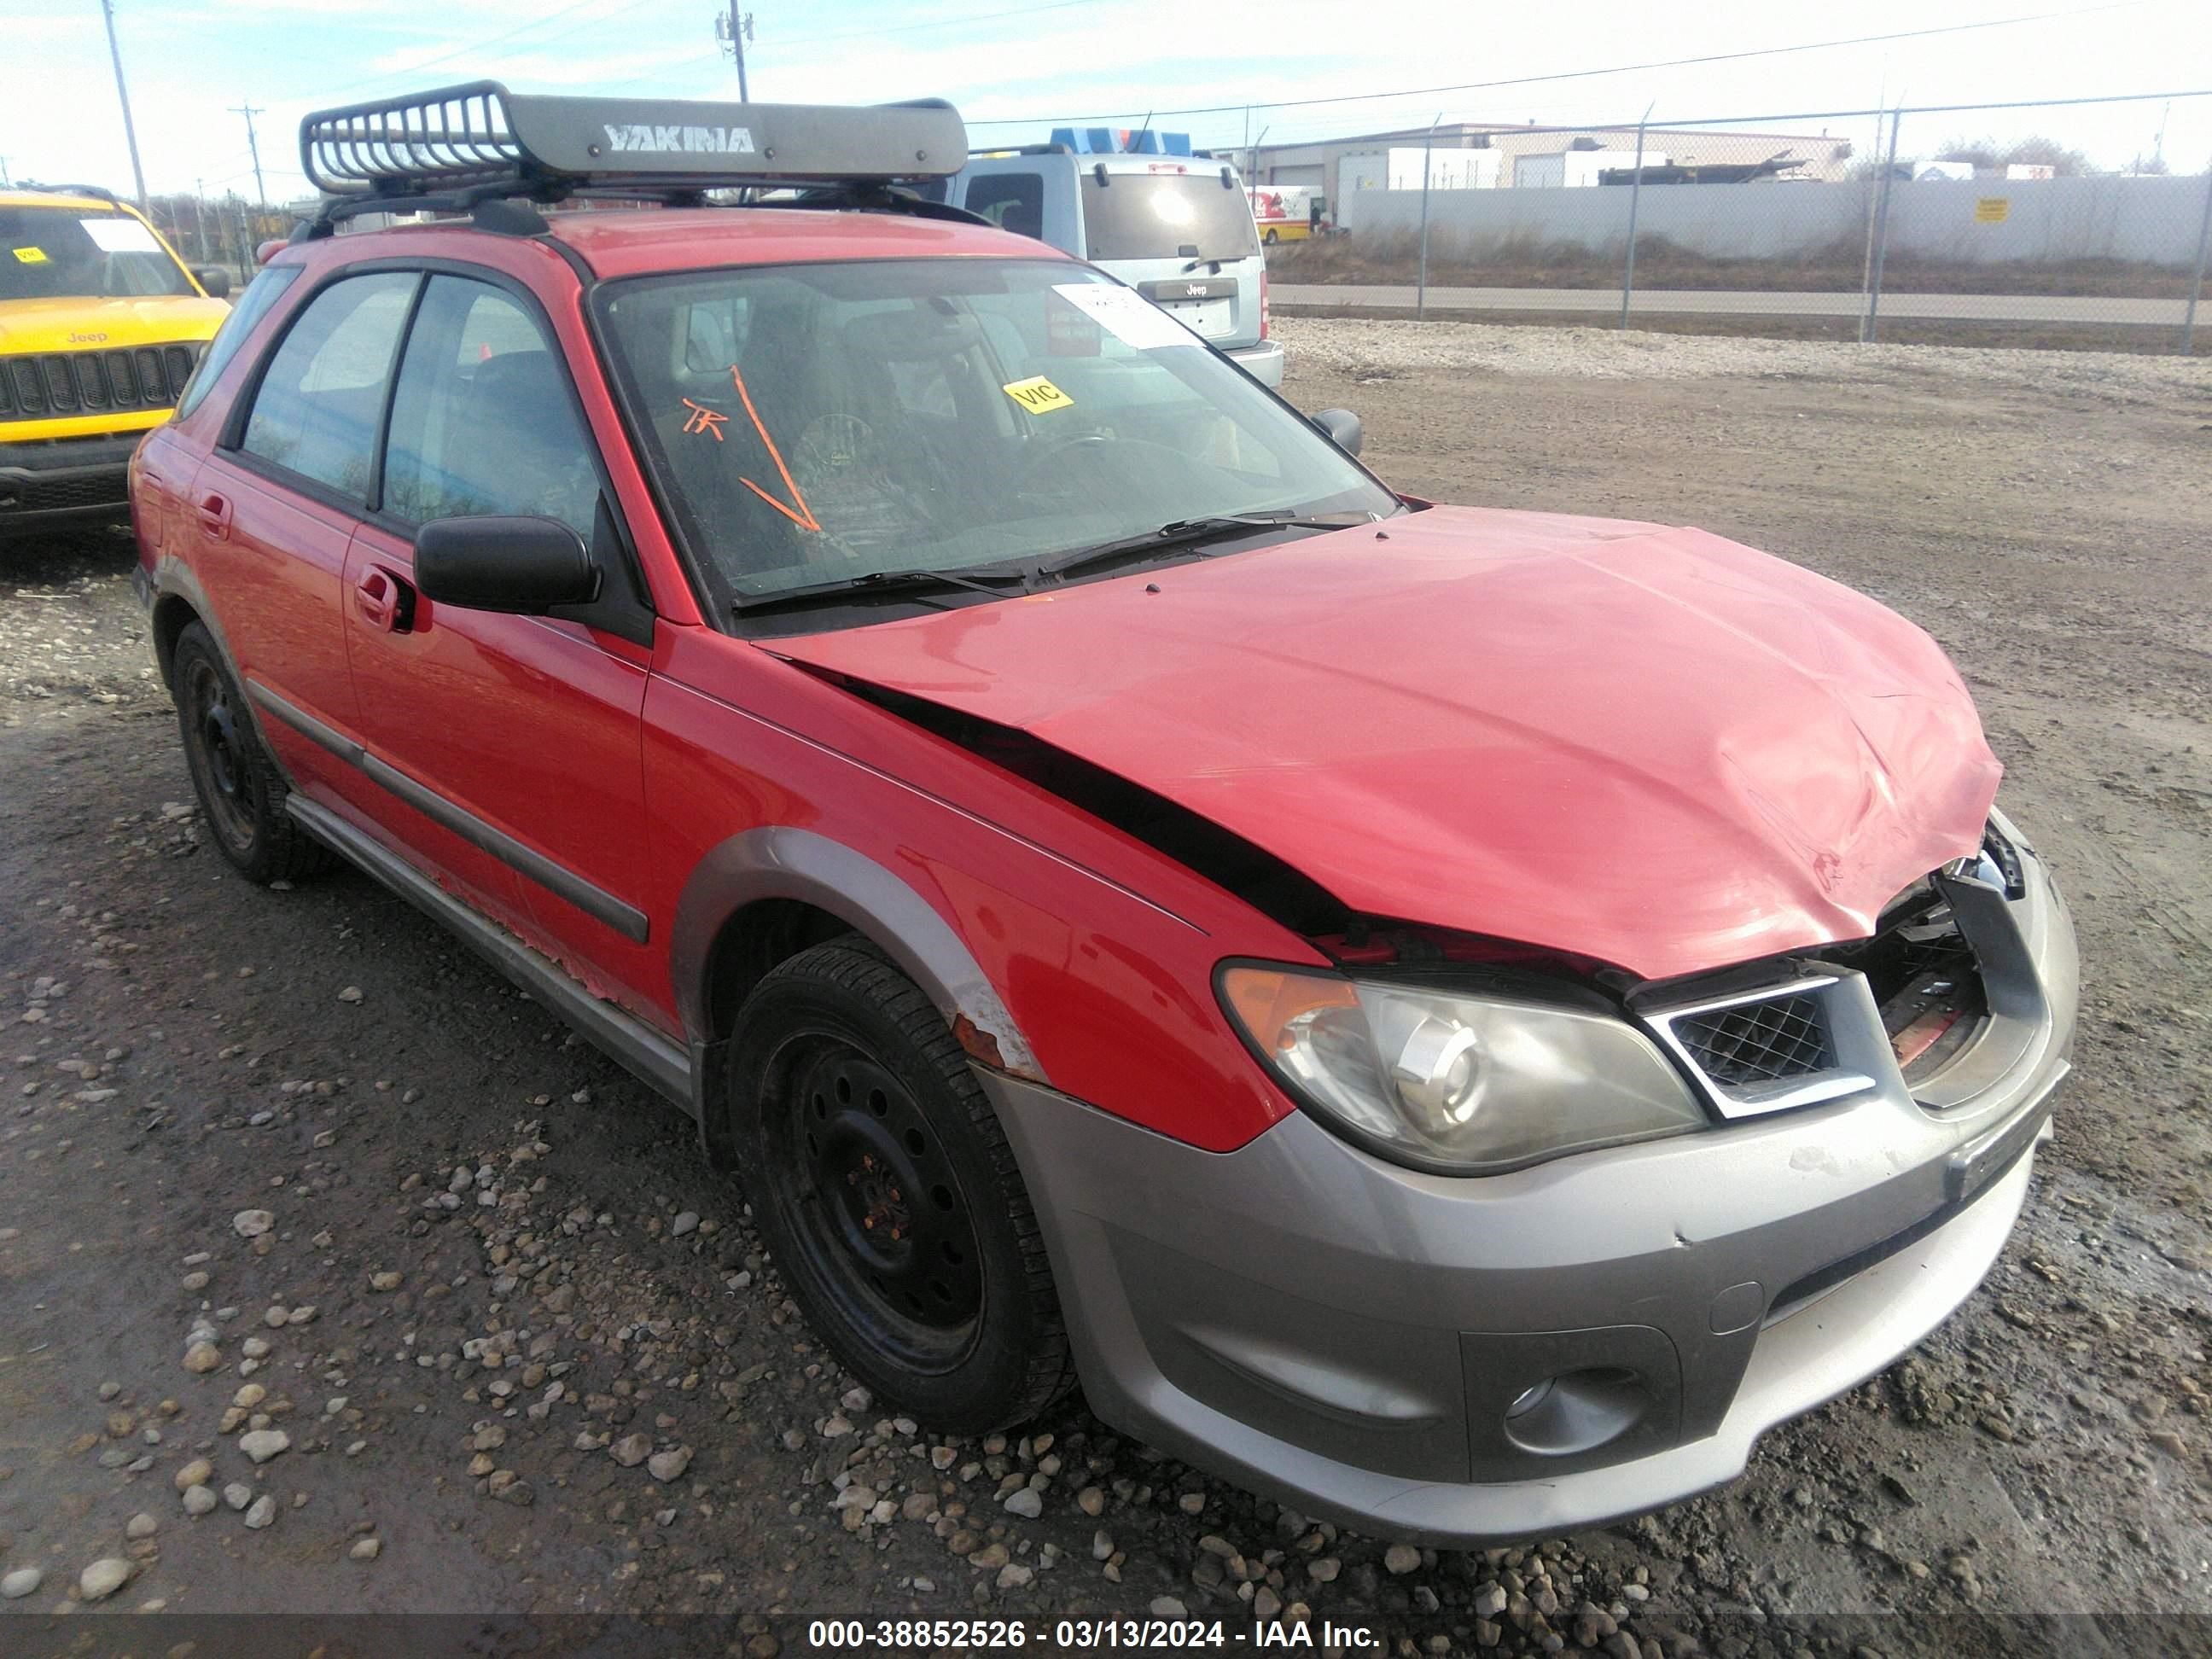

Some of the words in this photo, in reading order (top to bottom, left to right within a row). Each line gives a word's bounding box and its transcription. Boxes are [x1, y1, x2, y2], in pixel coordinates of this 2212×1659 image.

[603, 125, 755, 153] YAKIMA
[1186, 284, 1207, 297] Jeep
[68, 333, 108, 343] Jeep
[1014, 385, 1060, 405] VIC
